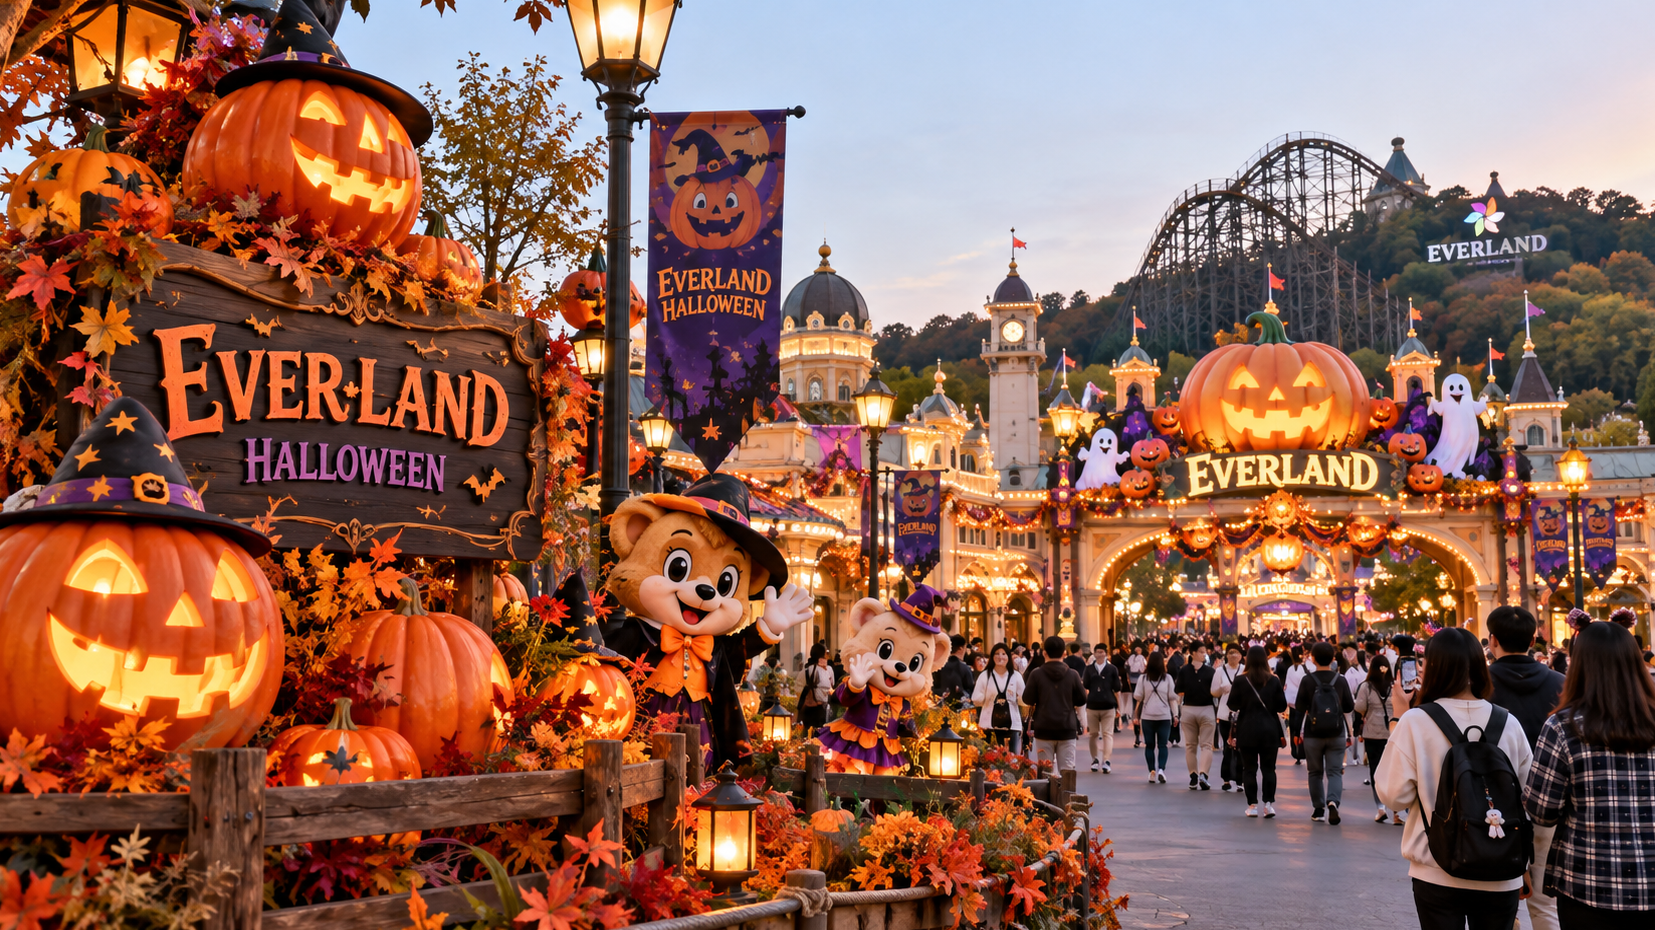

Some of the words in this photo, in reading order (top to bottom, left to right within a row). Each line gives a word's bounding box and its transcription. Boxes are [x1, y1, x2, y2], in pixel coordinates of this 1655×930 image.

[1427, 234, 1548, 262] EVERLAND
[657, 266, 772, 299] EVERLAND
[661, 294, 767, 322] HALLOWEEN
[153, 323, 509, 447] EVERLAND
[244, 437, 447, 492] HALLOWEEN
[1185, 452, 1379, 497] EVERLAND
